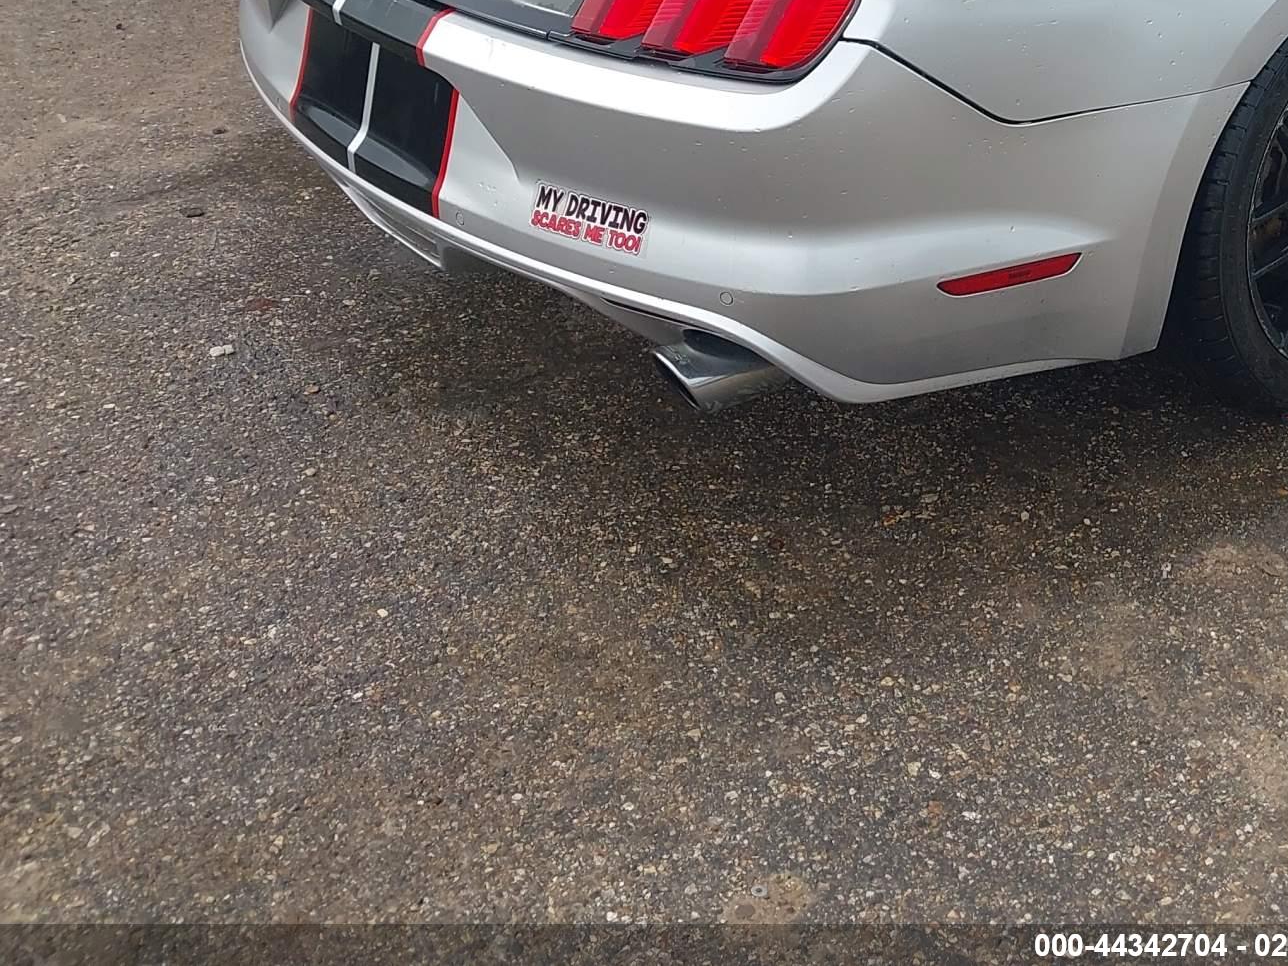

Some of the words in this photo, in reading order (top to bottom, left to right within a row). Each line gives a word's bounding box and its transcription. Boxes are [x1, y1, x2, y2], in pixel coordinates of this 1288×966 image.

[531, 210, 582, 238] SCARES
[583, 223, 606, 244] ME
[608, 229, 643, 253] TOO!
[536, 185, 565, 213] MY
[565, 194, 648, 235] DRIVING
